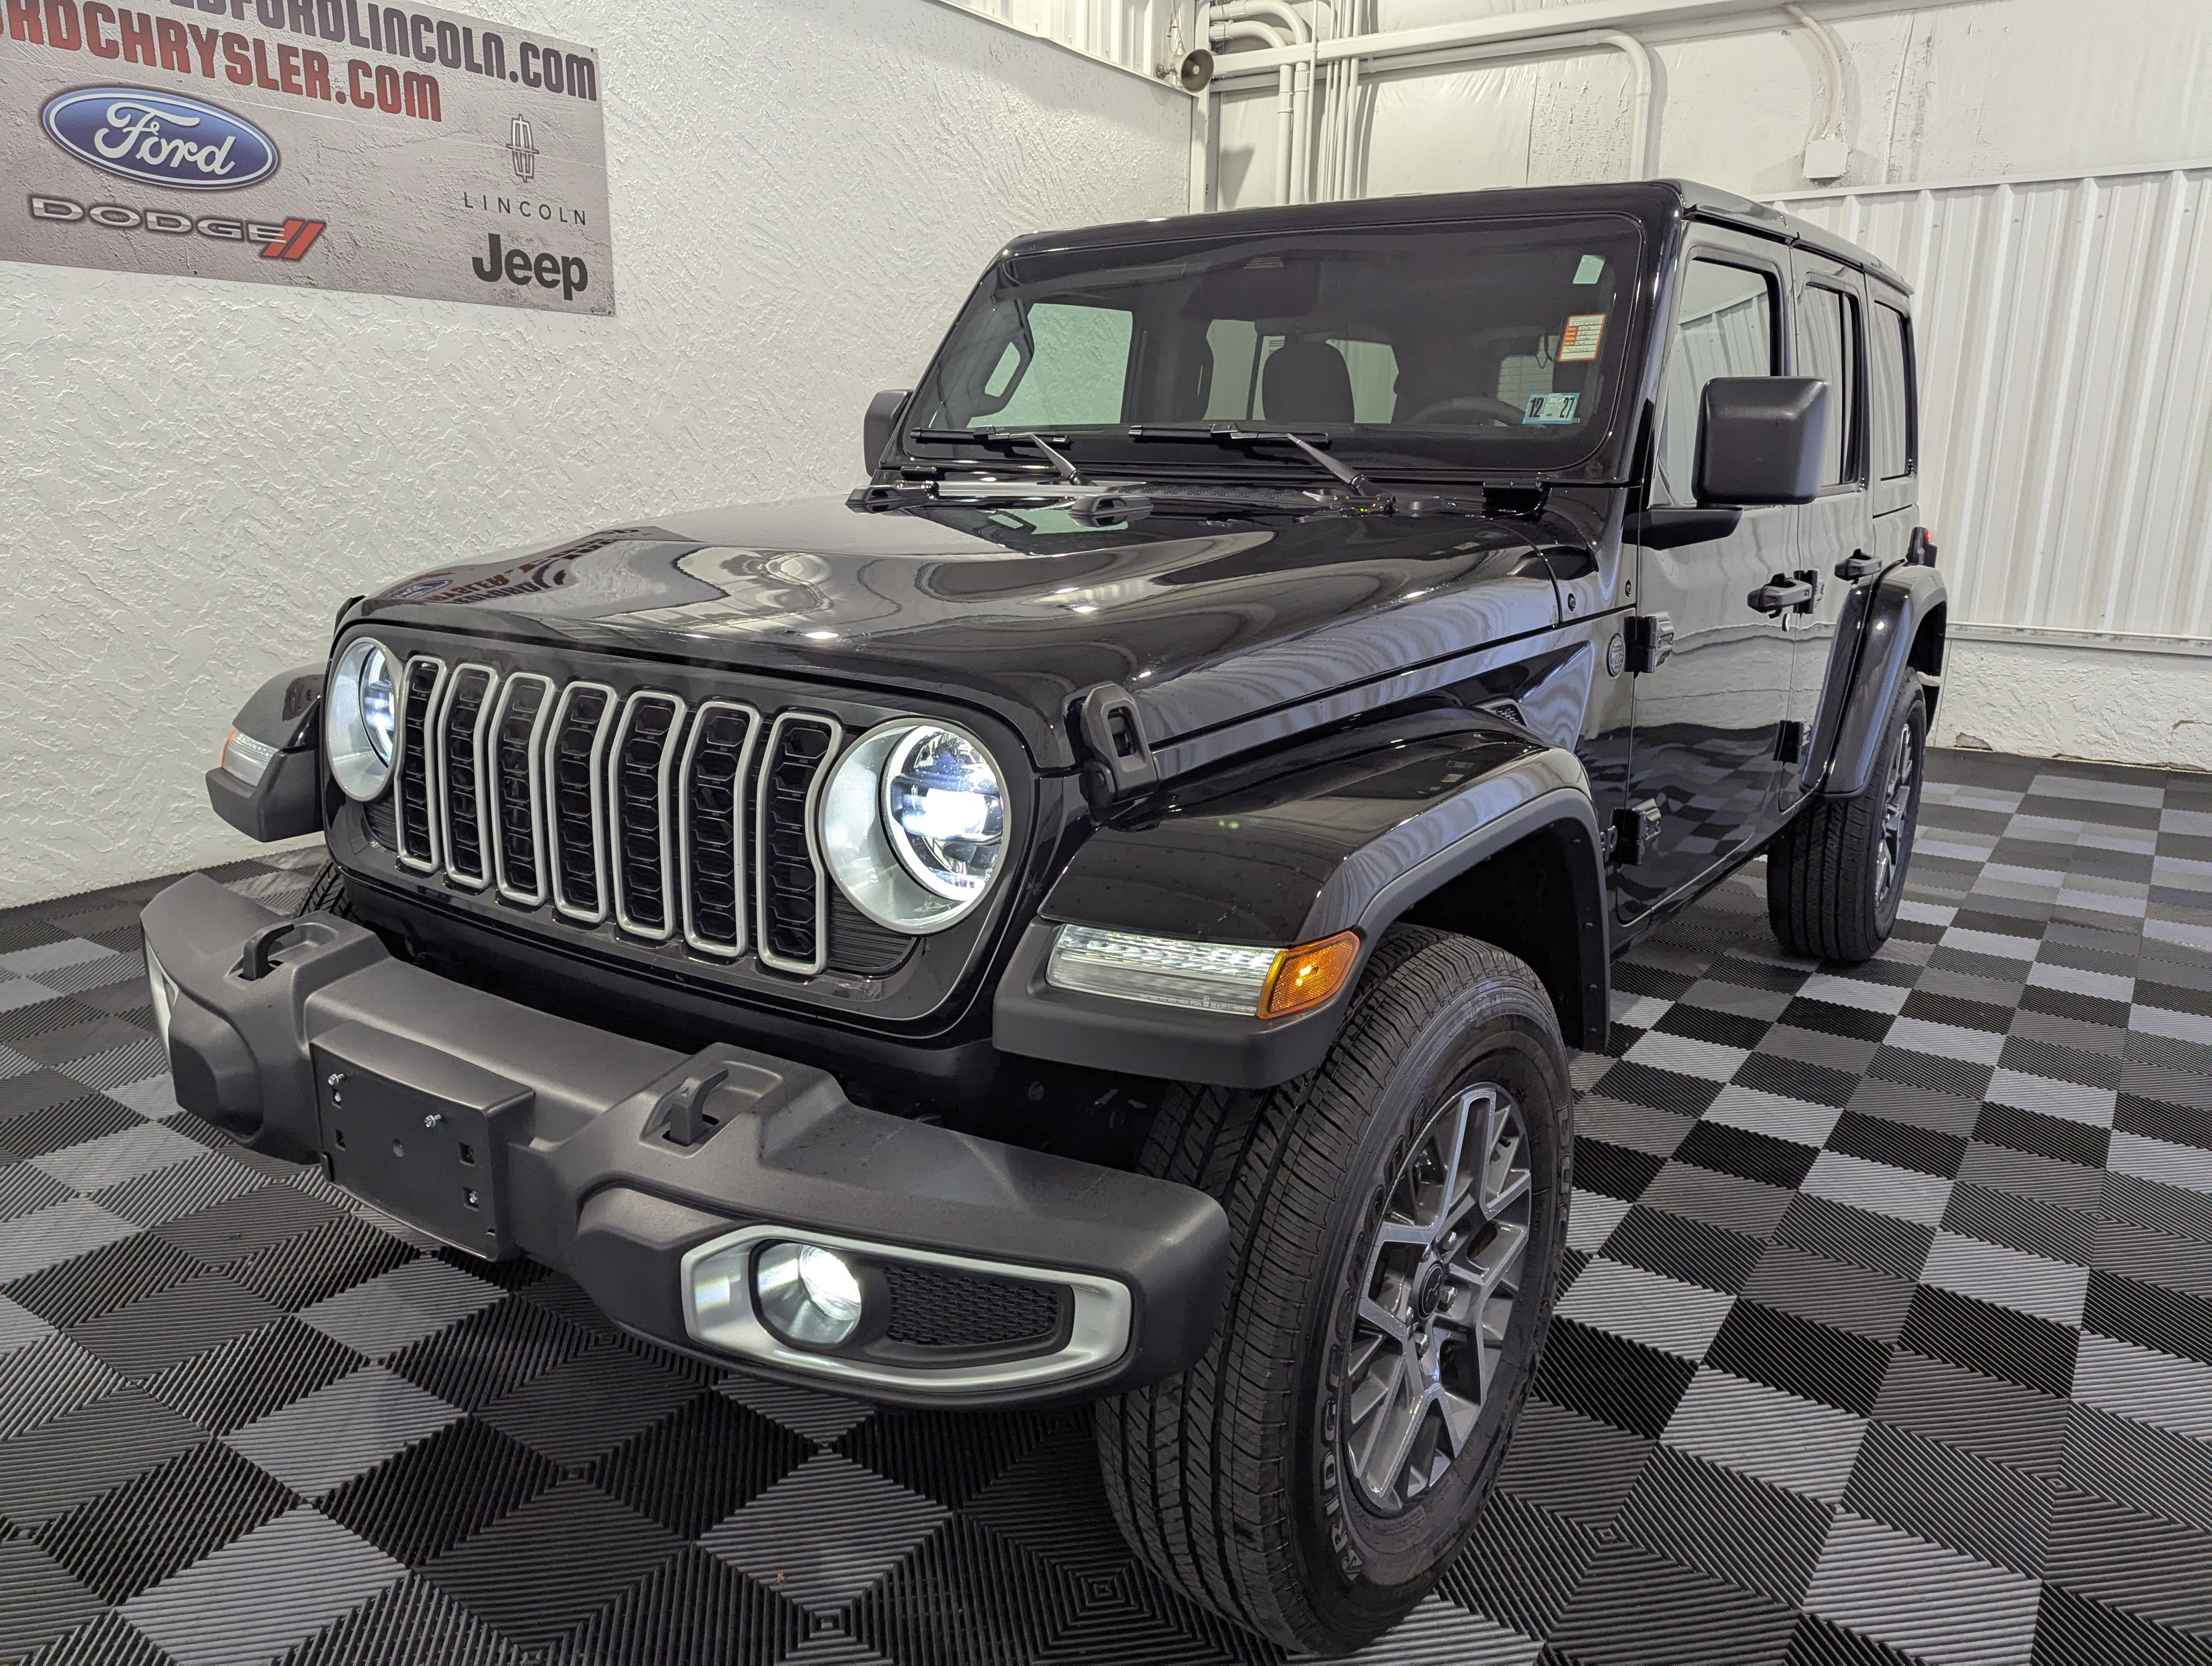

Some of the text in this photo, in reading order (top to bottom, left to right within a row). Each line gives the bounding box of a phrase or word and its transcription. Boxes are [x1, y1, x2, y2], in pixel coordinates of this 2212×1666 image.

[0, 0, 442, 122] RDCHRYSLER.COM
[170, 0, 597, 101] ORDLINCOLN.COM
[94, 101, 235, 175] Ford
[31, 197, 287, 244] DODGE
[464, 191, 586, 226] LINCOLN
[472, 233, 588, 301] Jeep
[1529, 397, 1545, 418] 12
[1559, 397, 1575, 418] 27
